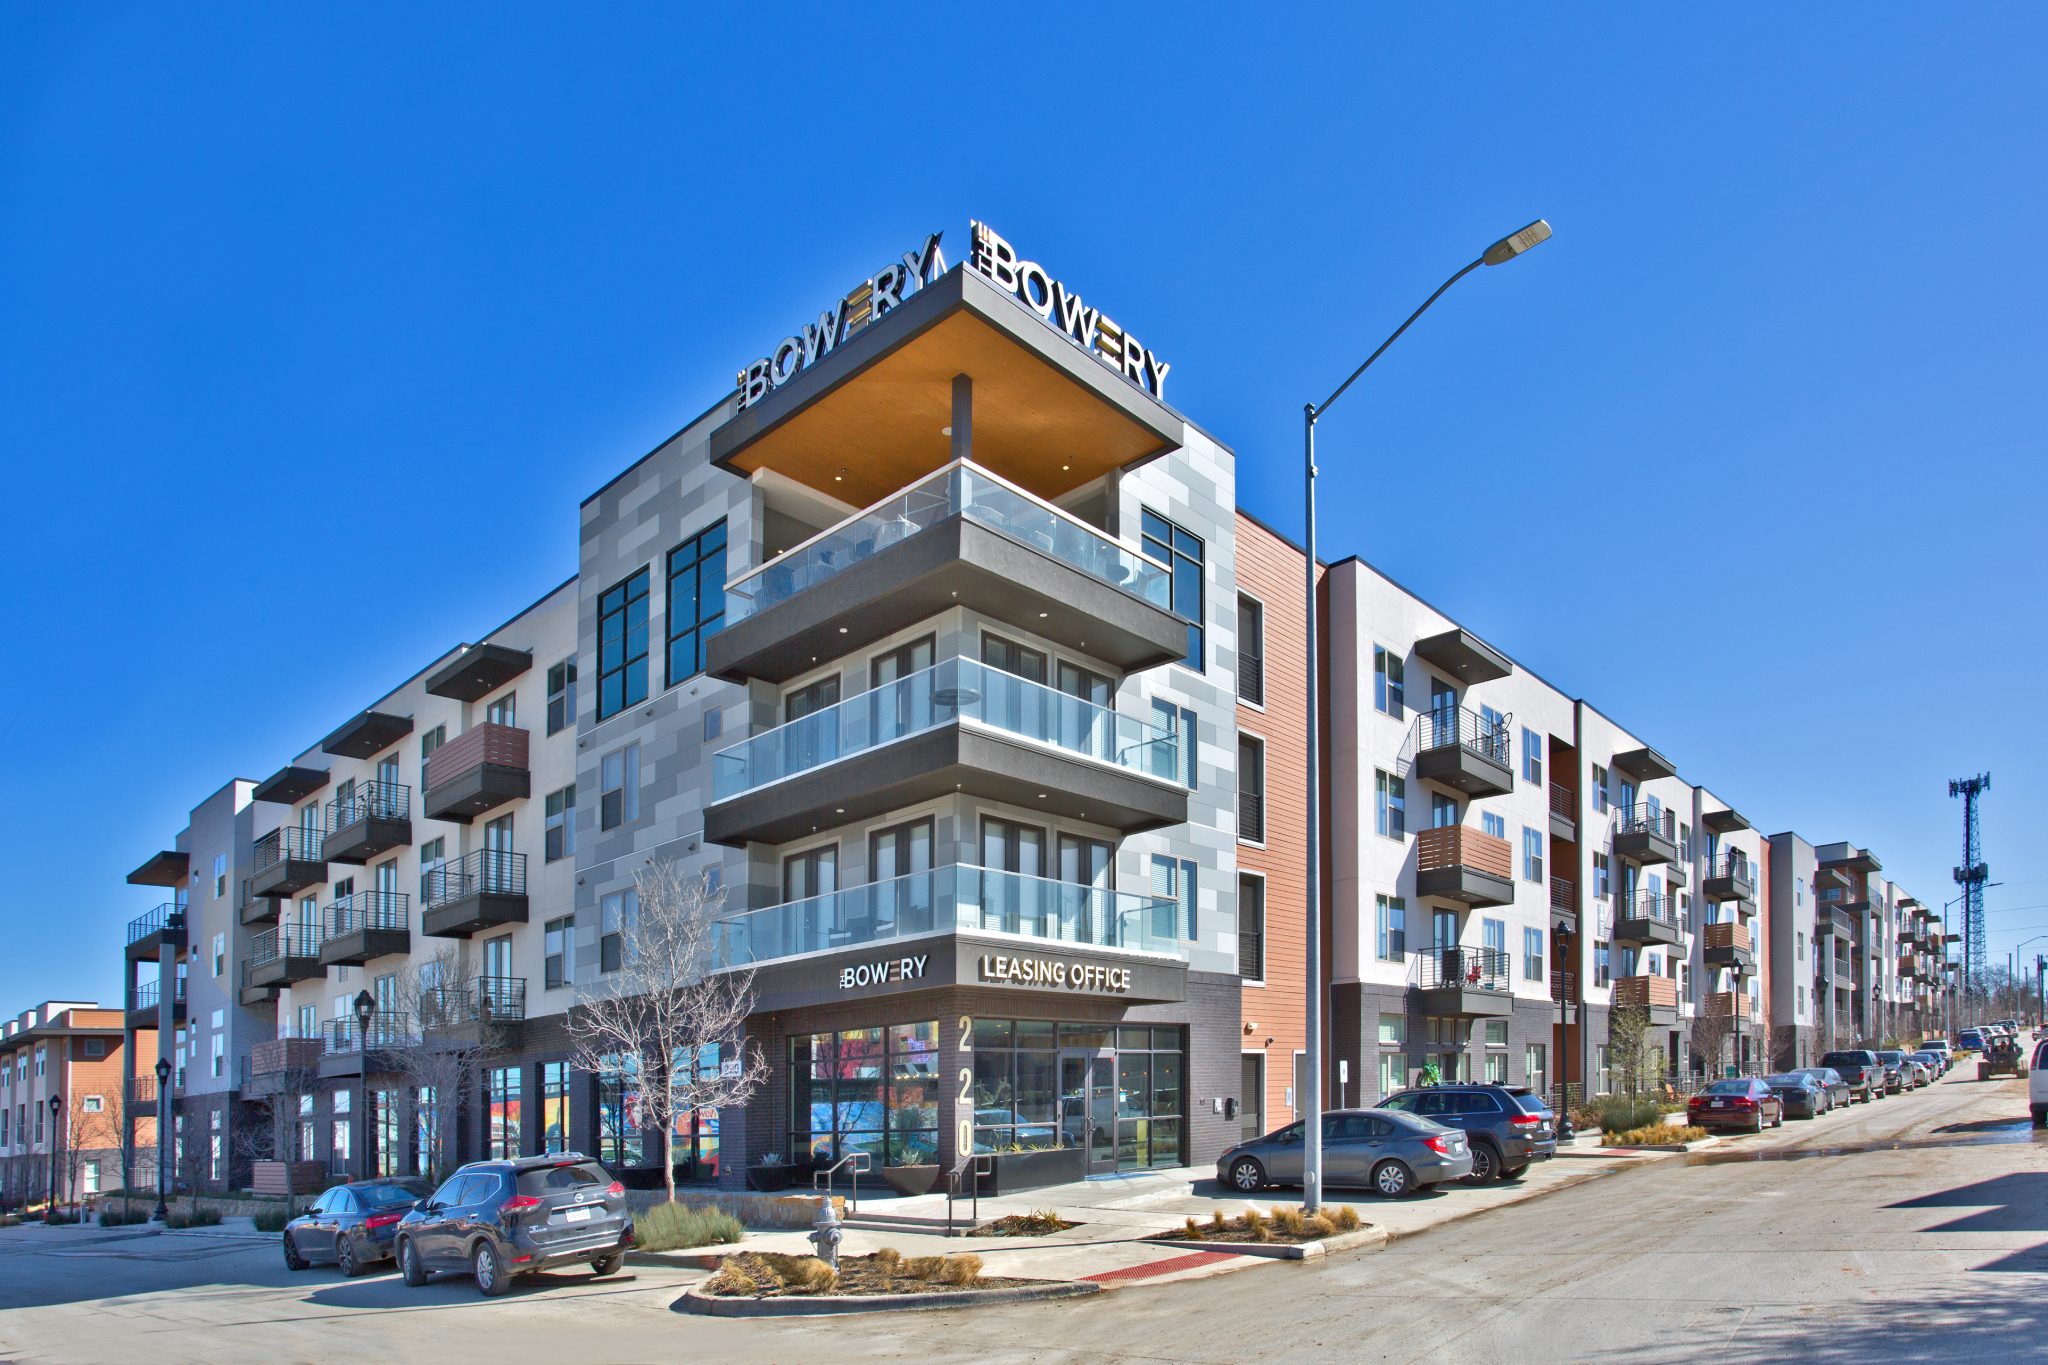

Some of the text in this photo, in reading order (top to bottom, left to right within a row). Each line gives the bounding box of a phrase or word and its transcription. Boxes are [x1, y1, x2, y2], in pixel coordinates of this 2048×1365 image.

[746, 232, 938, 408] BOWERY
[990, 229, 1171, 402] BOWERY
[844, 955, 927, 988] BOWERY
[984, 955, 1131, 989] LEASING OFFICE
[959, 1015, 972, 1157] 220
